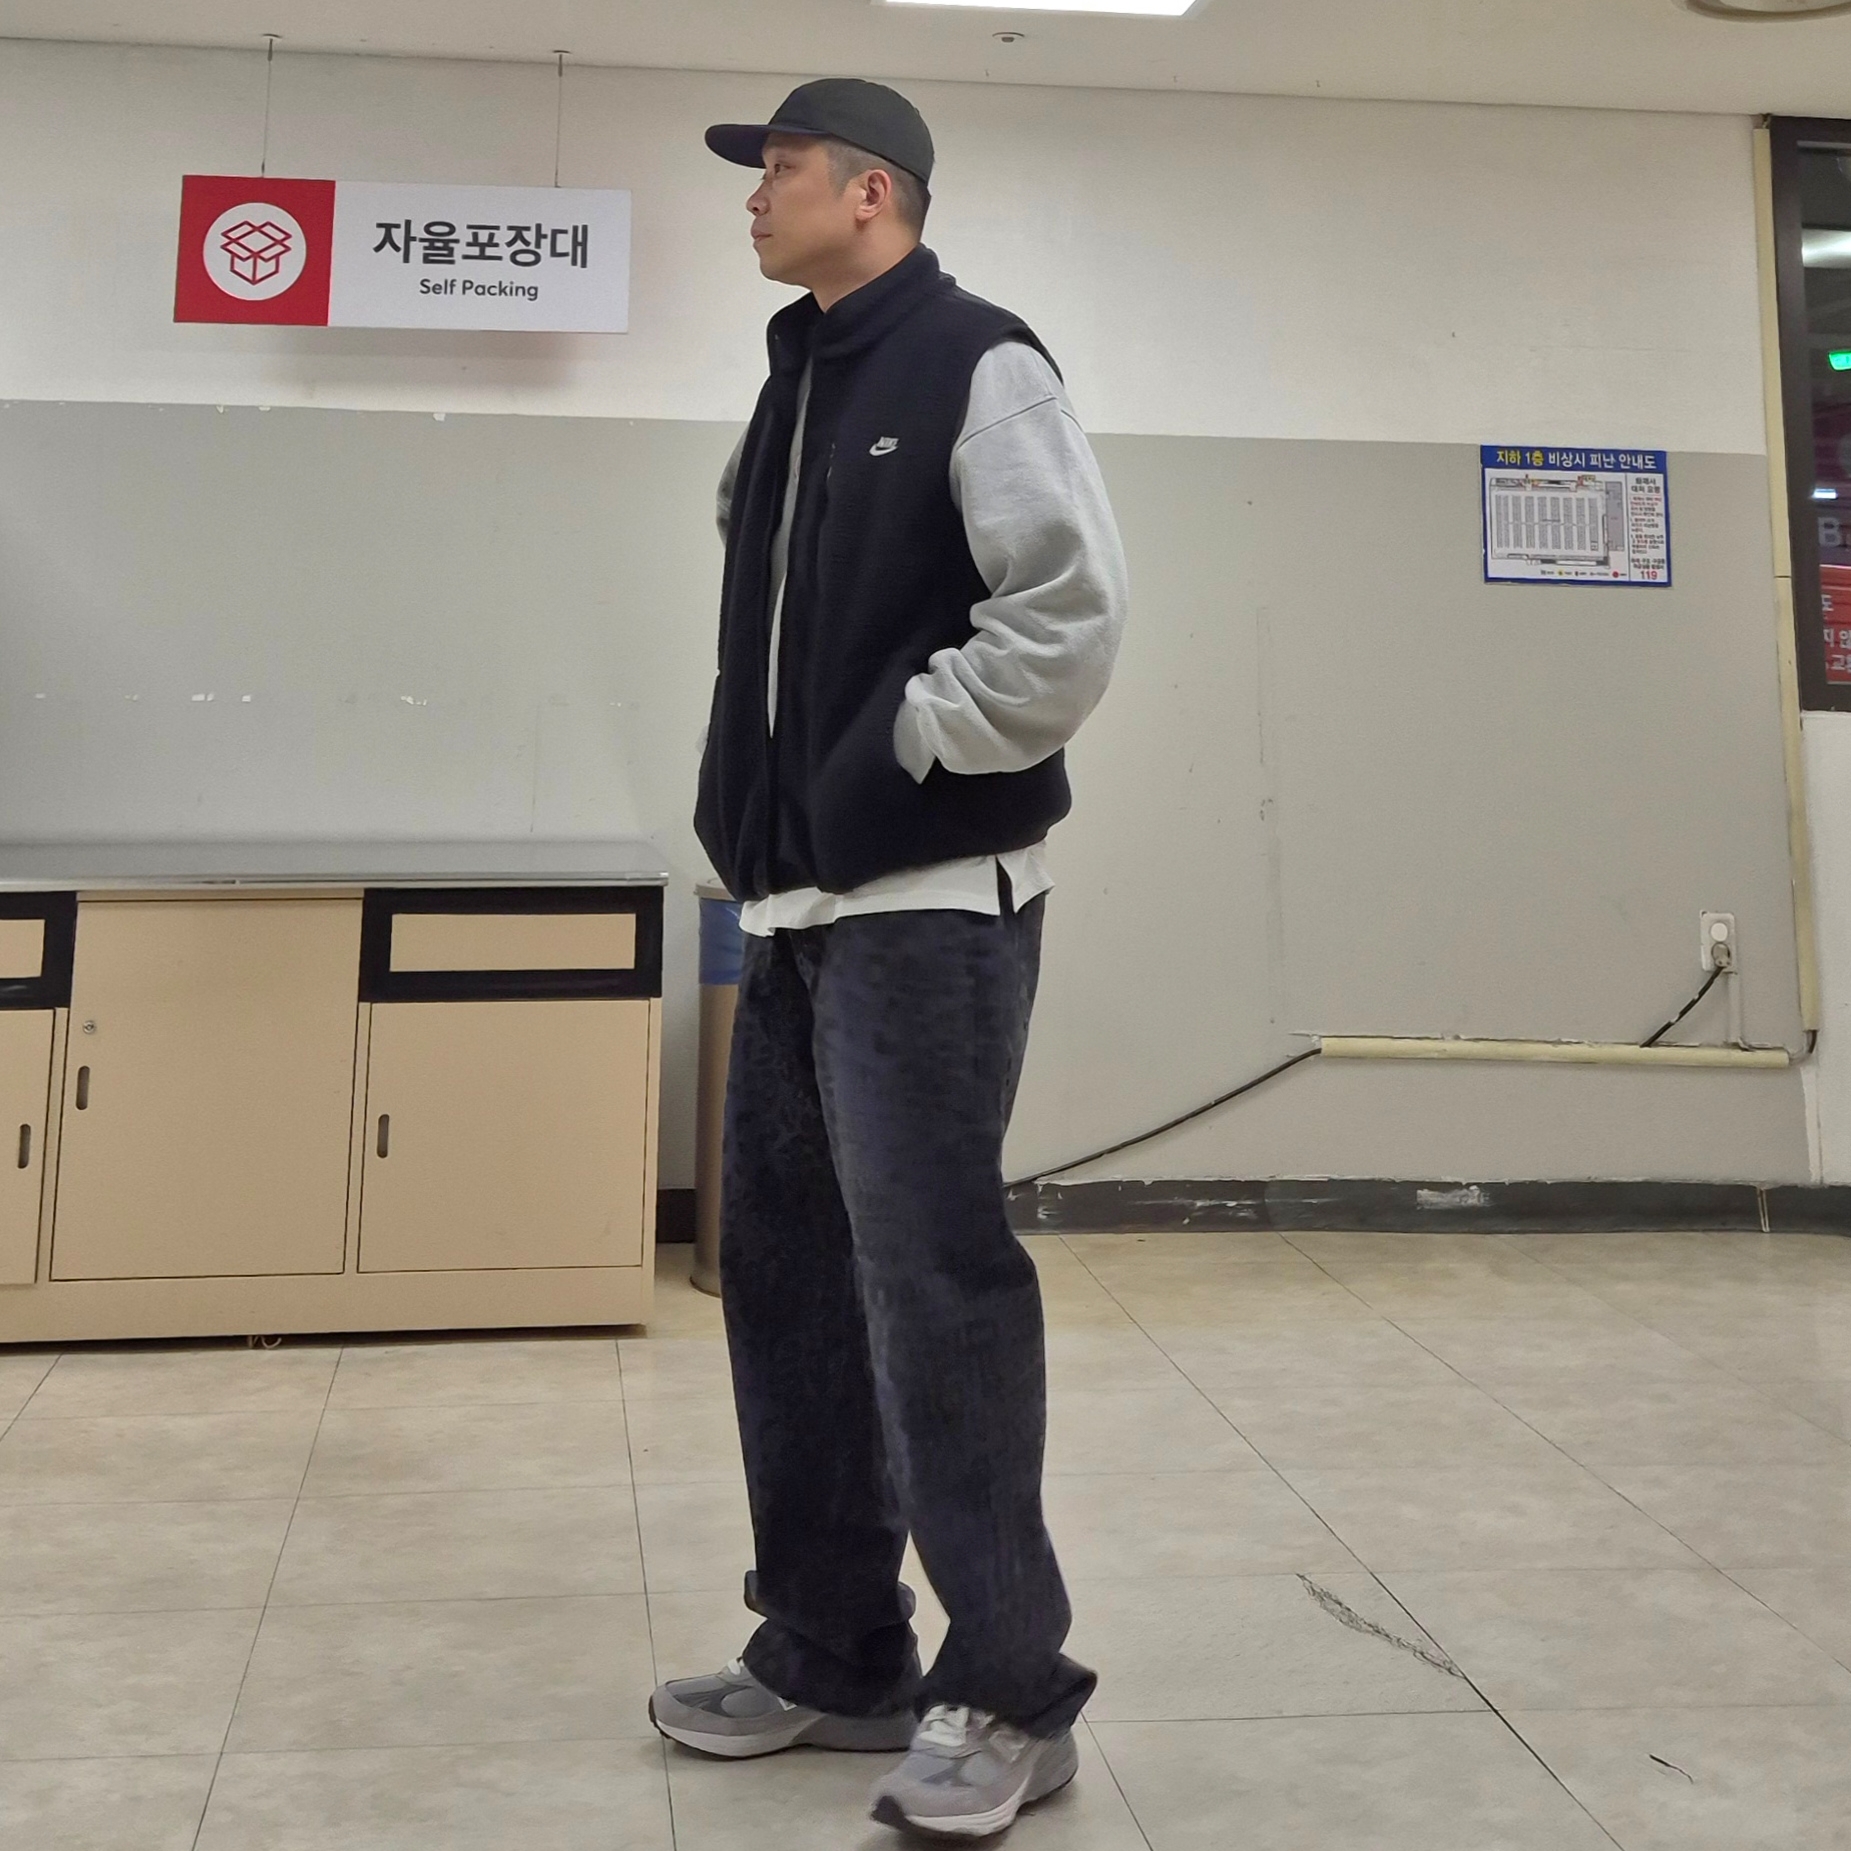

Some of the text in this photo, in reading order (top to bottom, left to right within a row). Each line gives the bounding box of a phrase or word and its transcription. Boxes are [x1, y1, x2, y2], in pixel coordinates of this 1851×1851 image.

[372, 218, 589, 269] 자율포장대
[419, 278, 539, 302] Self Packing
[1496, 450, 1657, 470] 지하 1층 비상시 피난 안내도
[1640, 570, 1658, 580] 119
